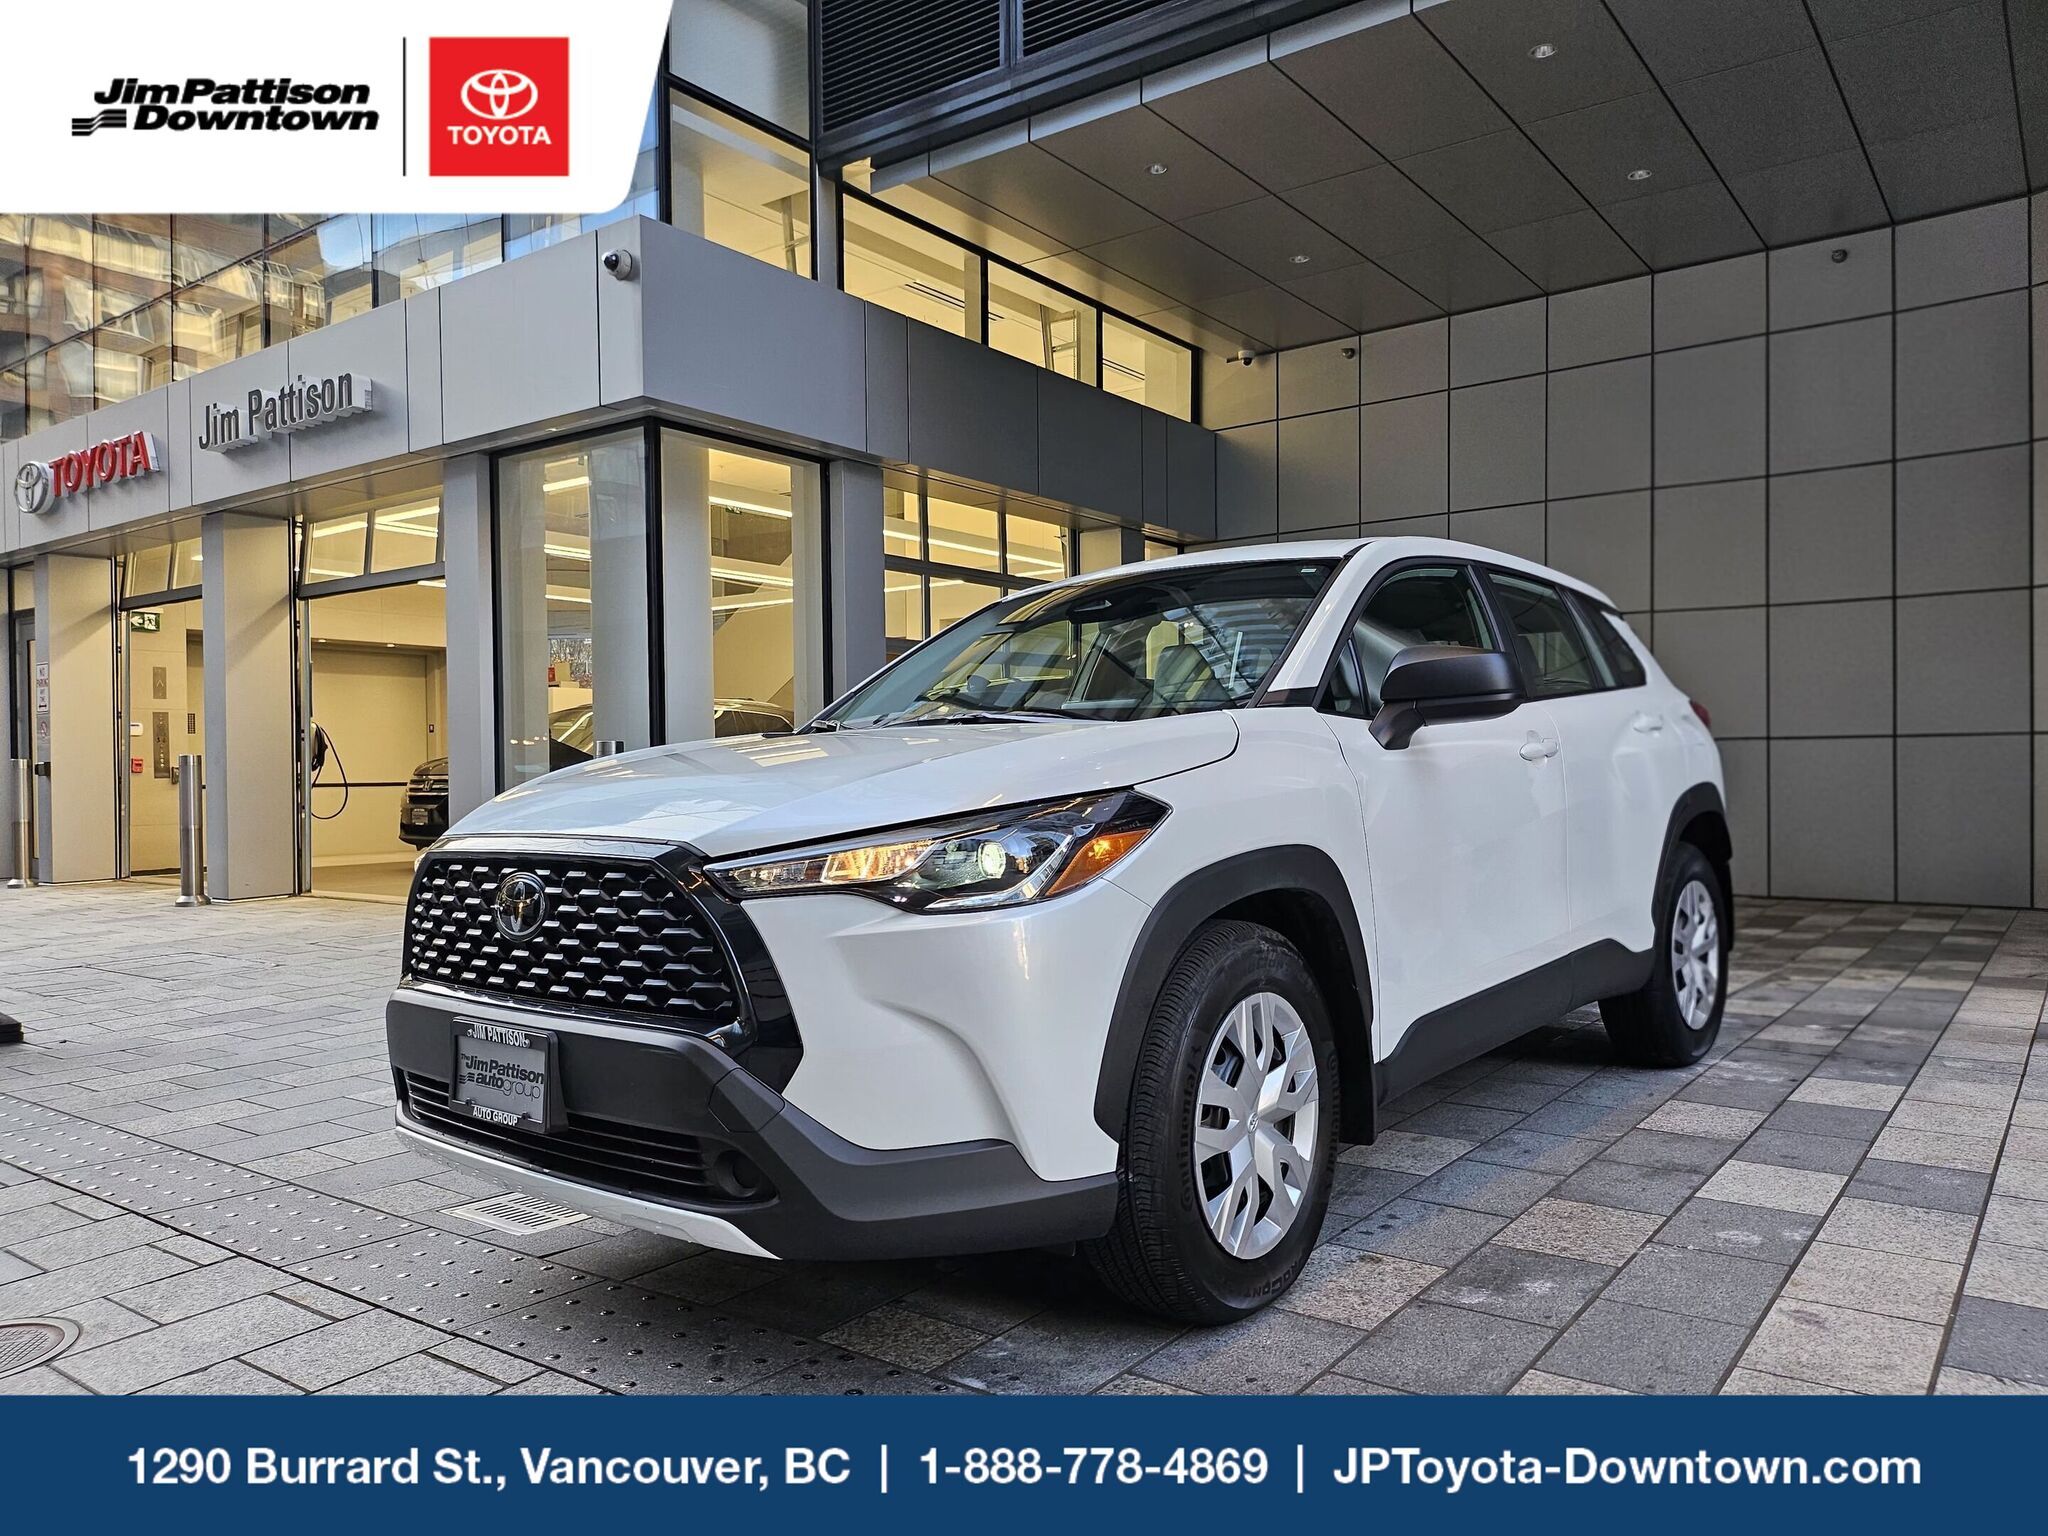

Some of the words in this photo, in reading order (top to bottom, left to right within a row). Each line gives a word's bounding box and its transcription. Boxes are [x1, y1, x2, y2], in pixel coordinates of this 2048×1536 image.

[199, 402, 240, 450] Jim
[248, 373, 353, 437] Pattison
[49, 430, 153, 498] TOYOTA
[472, 1023, 487, 1041] JIM
[487, 1027, 526, 1048] PATTISON
[472, 1105, 492, 1120] AUTO
[492, 1109, 519, 1127] GROUP
